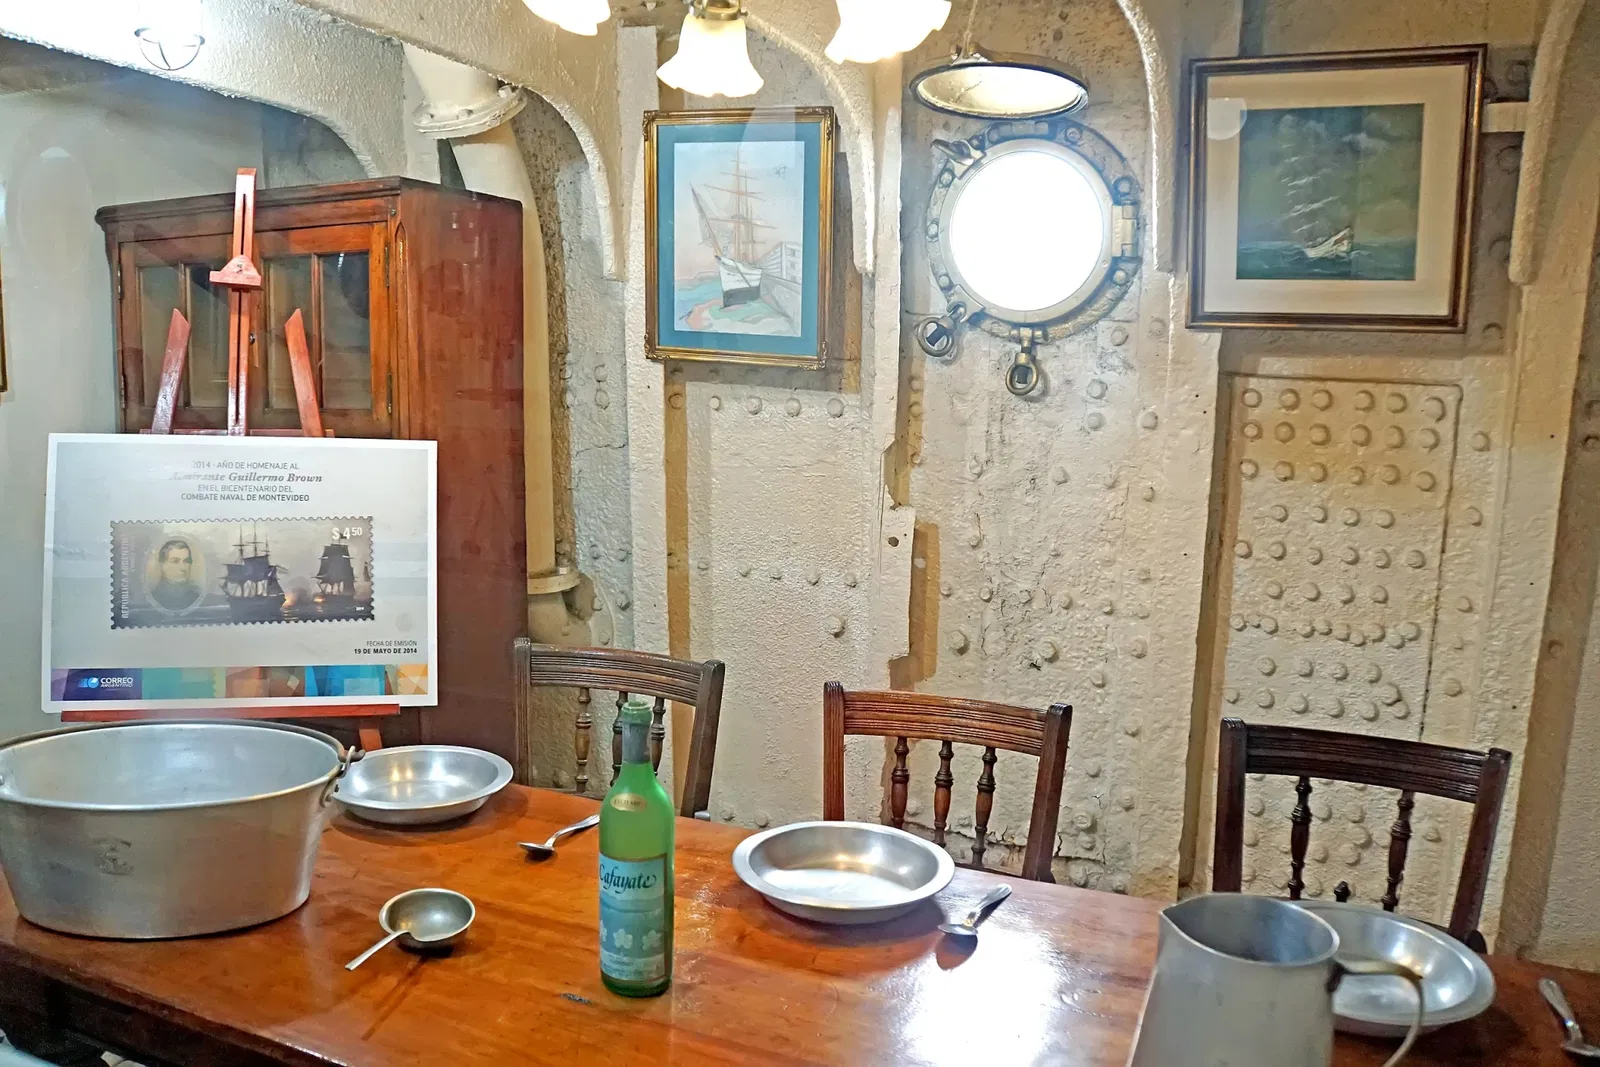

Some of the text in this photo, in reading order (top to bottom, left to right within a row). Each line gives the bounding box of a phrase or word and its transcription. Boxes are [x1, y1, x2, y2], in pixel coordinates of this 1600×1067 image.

[192, 461, 211, 469] 2014
[216, 460, 234, 469] AÑO
[235, 461, 245, 469] DE
[246, 462, 288, 470] HOMENAJE
[289, 462, 299, 470] AL
[229, 472, 284, 482] Guillermo
[287, 473, 322, 483] Brown
[198, 484, 293, 493] EN EL BICENTENARIO DEL
[181, 493, 218, 501] COMBATE
[220, 493, 245, 501] NAVAL
[258, 494, 310, 502] MONTEVIDEO
[599, 864, 657, 894] Cafayate
